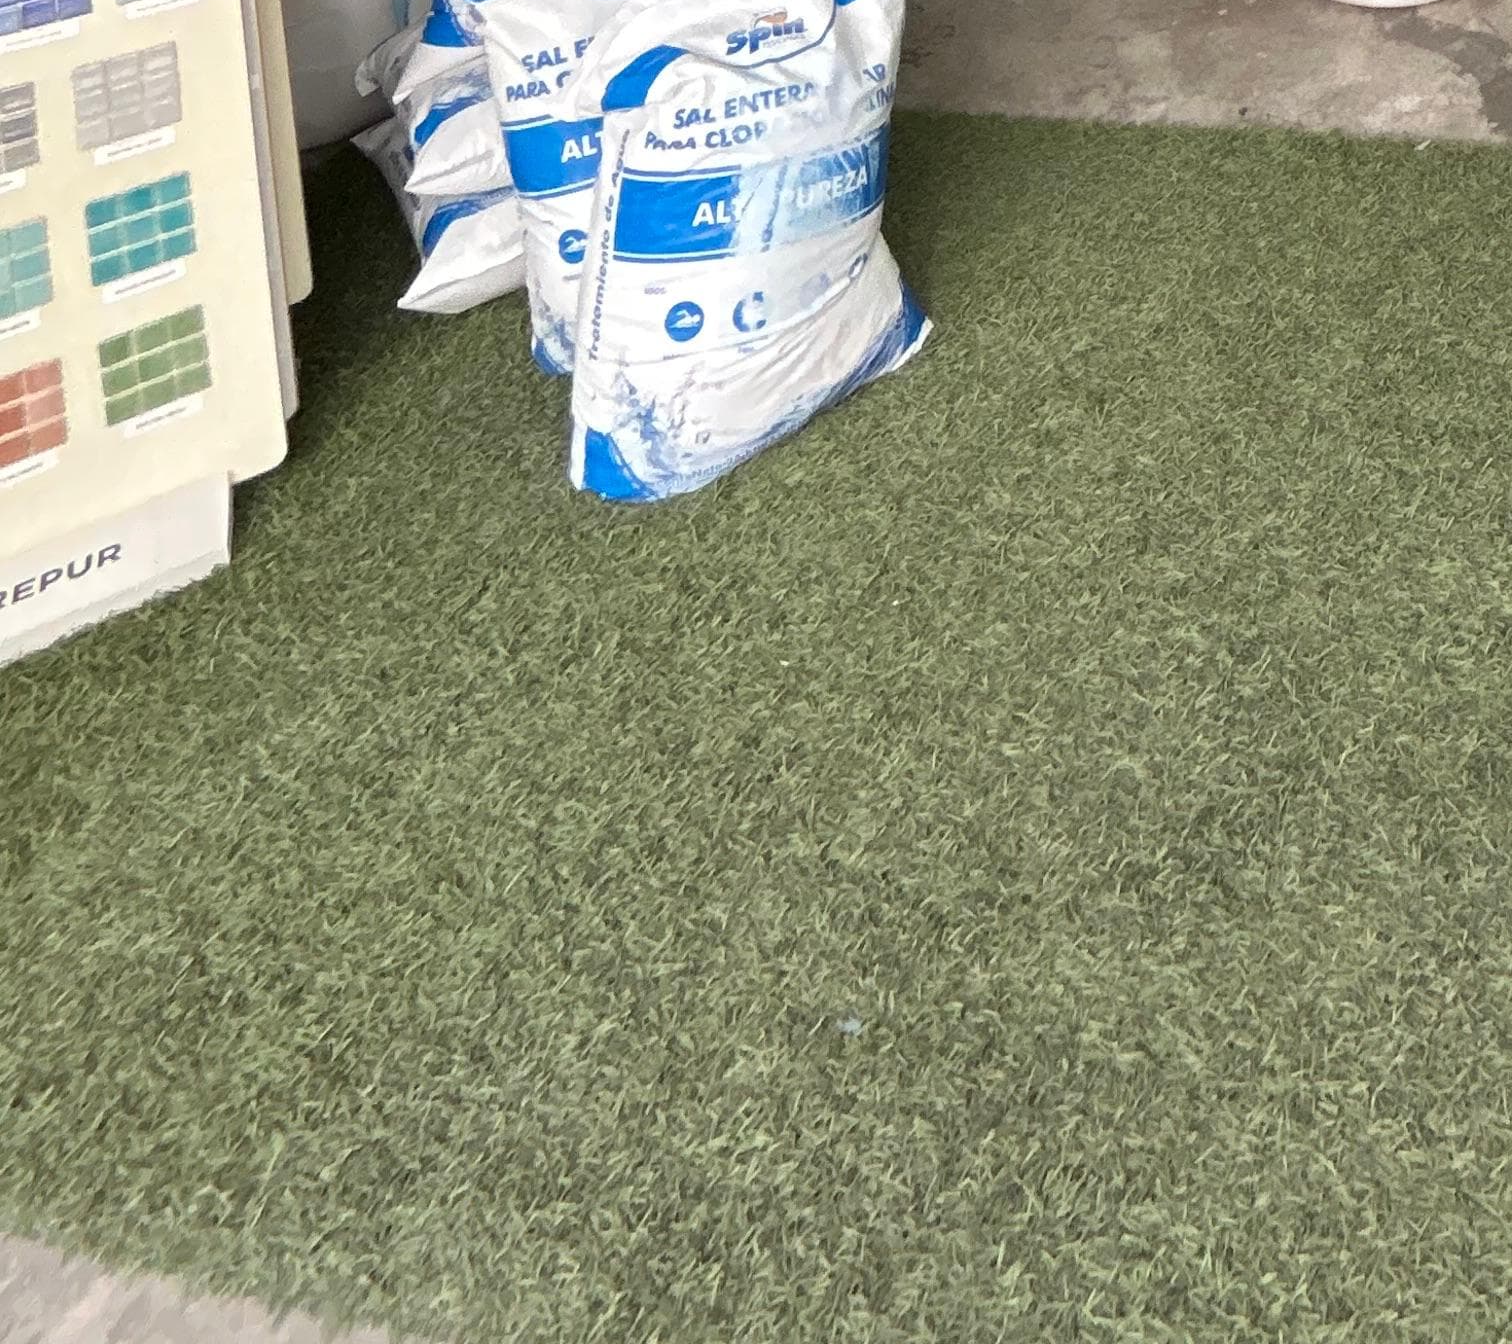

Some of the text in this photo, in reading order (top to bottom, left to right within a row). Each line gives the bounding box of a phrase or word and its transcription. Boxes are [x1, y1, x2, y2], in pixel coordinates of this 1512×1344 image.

[521, 46, 568, 73] SAL
[505, 80, 551, 103] PARA
[673, 108, 717, 130] SAL
[588, 128, 631, 362] Tratamiento de Agua
